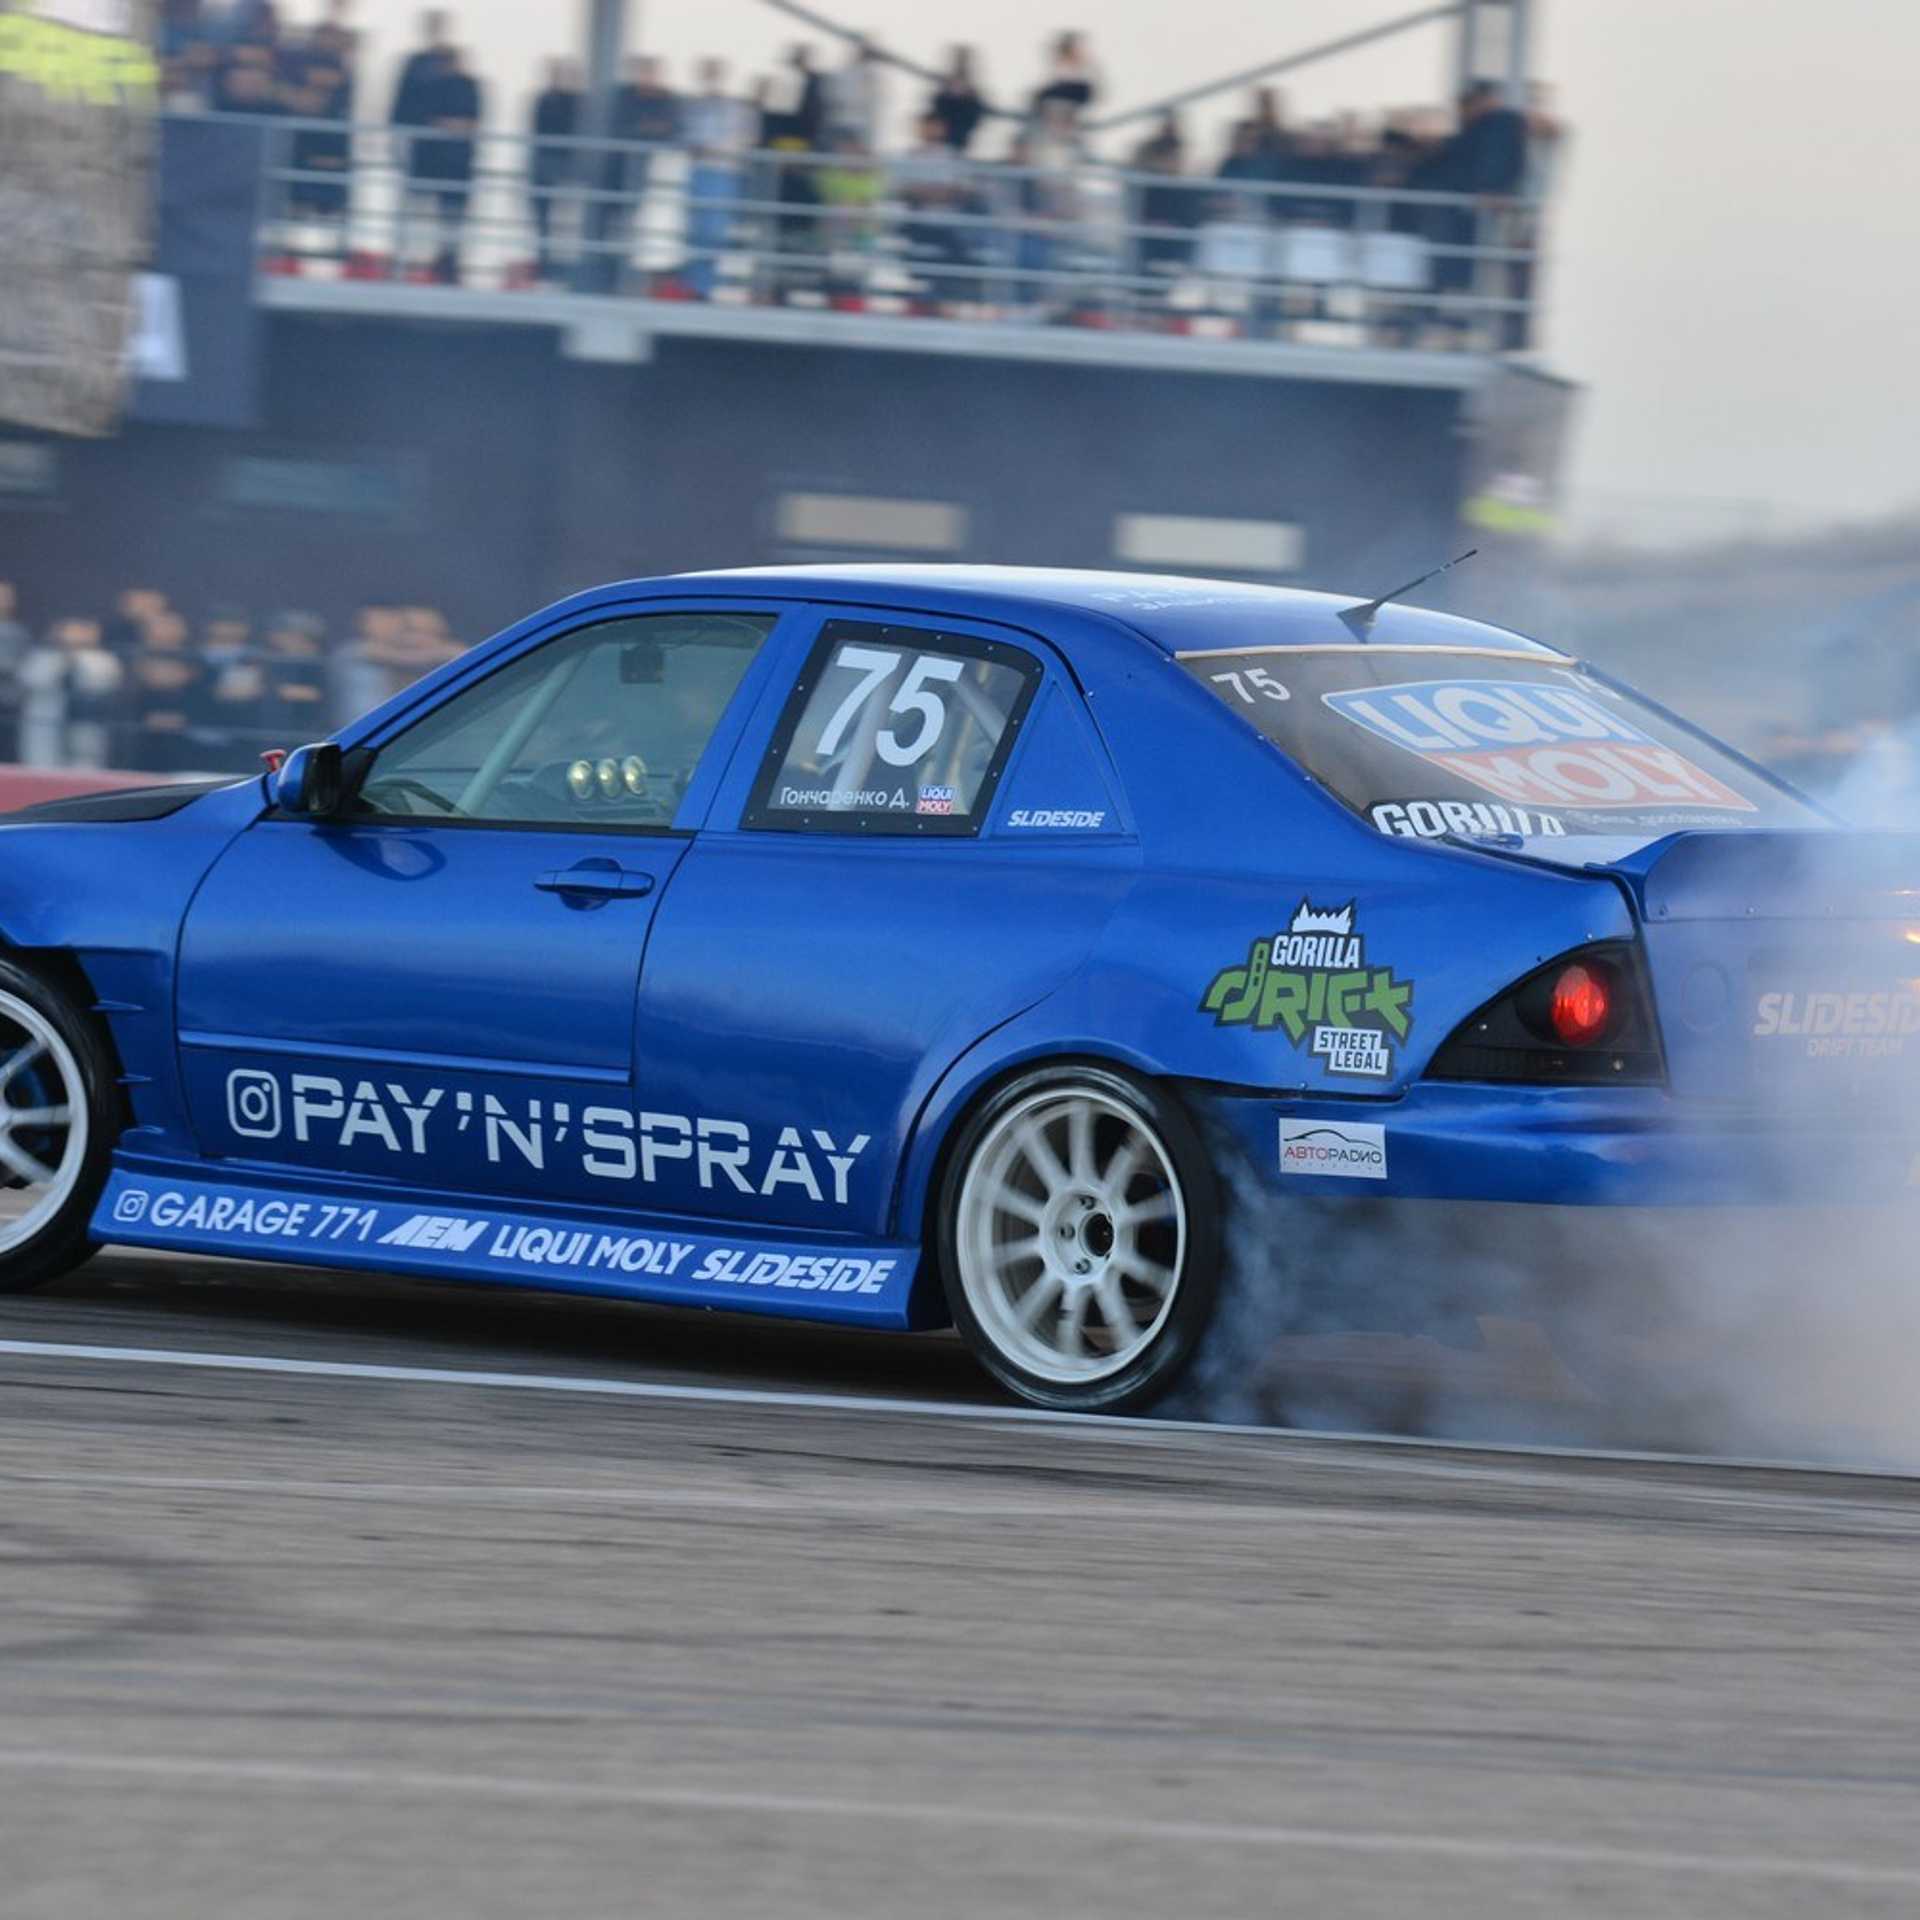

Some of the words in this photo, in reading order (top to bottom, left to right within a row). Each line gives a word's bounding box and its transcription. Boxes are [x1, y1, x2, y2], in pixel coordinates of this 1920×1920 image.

[1210, 668, 1291, 704] 75
[815, 646, 966, 767] 75
[1344, 684, 1642, 750] LIQUI
[1452, 746, 1738, 801] MOLY
[779, 786, 888, 807] Гончаренко
[918, 801, 952, 815] MOLY
[921, 786, 956, 800] LIQUI
[1008, 810, 1105, 828] SLIDESIDE
[1271, 934, 1361, 969] GORILLA
[1319, 1030, 1379, 1050] STREET
[1334, 1051, 1383, 1070] LEGAL
[1284, 1145, 1383, 1164] АВТОРАДИО
[150, 1191, 311, 1237] GARAGE
[309, 1204, 380, 1242] 771
[377, 1213, 490, 1252] AEM
[489, 1224, 593, 1264] LIQUI
[588, 1236, 696, 1275] MOLY
[692, 1249, 898, 1294] SLIDESIDE
